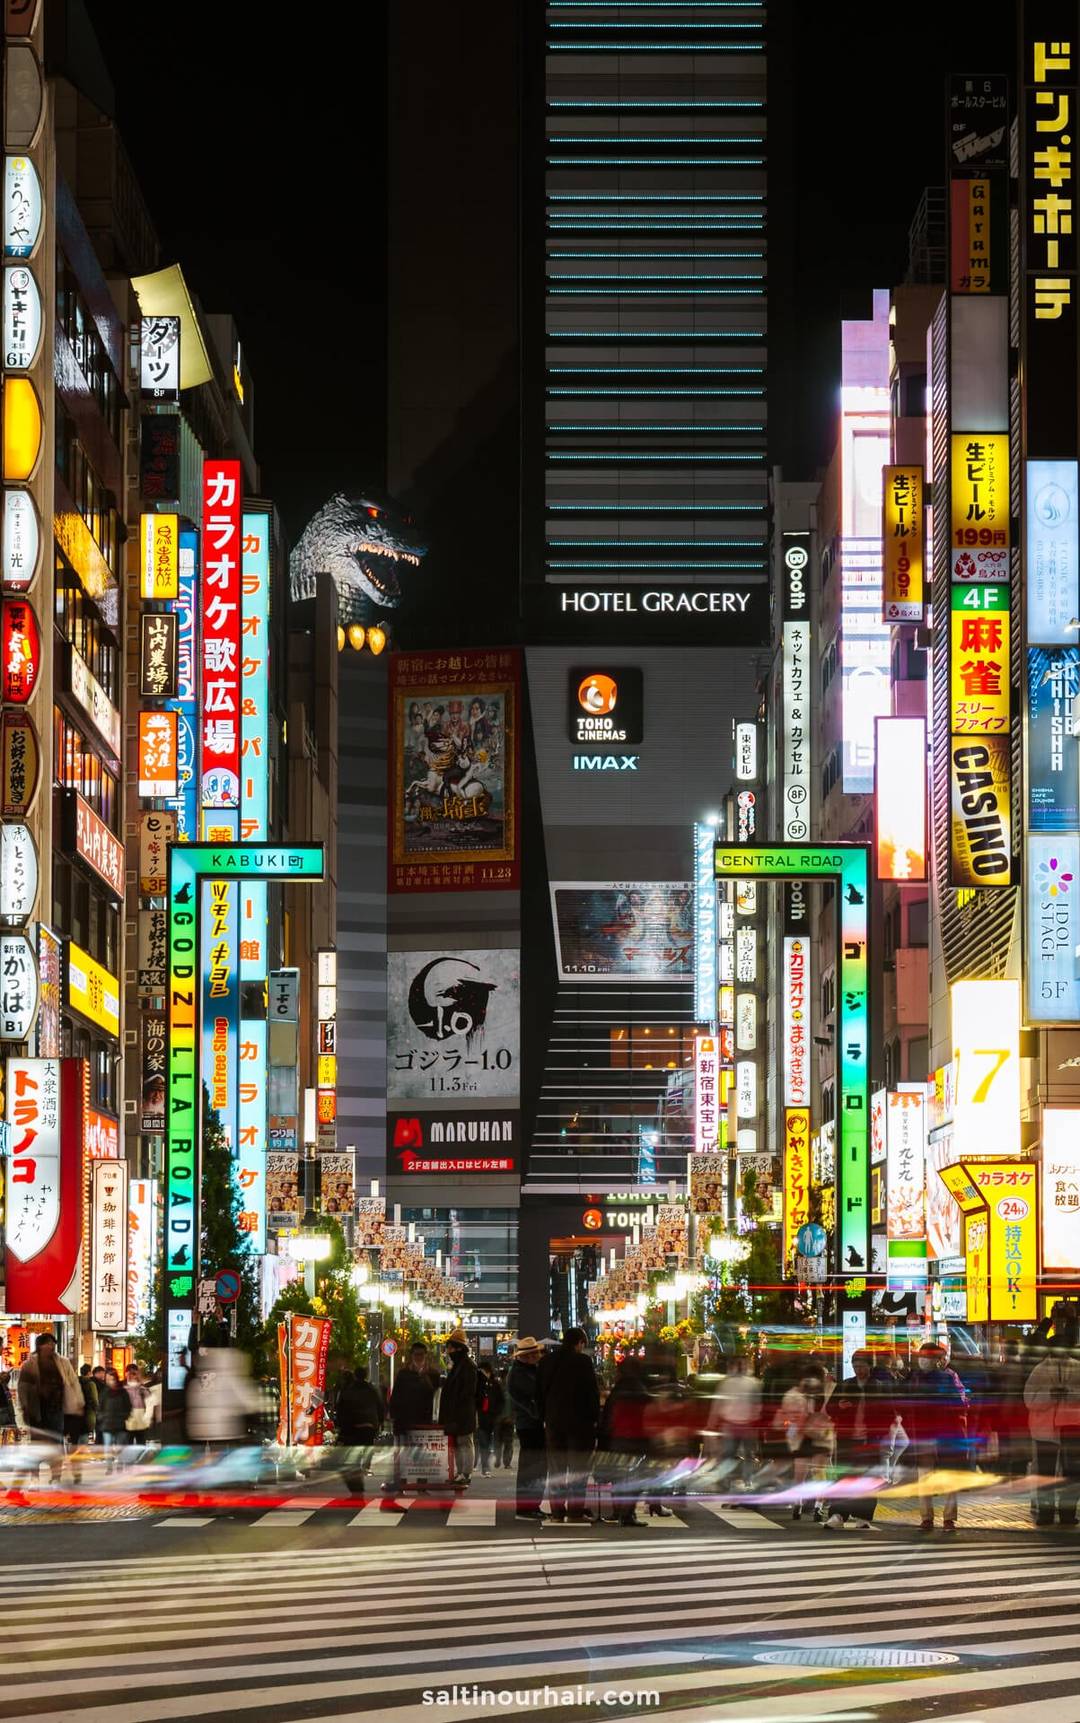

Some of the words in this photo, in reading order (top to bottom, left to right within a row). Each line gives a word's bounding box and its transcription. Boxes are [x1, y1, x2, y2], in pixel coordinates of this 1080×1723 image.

[1033, 42, 1072, 319] ドン・キホーテ
[12, 247, 26, 256] 7F
[6, 353, 30, 367] 6F
[149, 322, 172, 382] ダーツ
[153, 388, 166, 397] 8F
[965, 442, 986, 522] 生ビール
[892, 474, 909, 538] 生ビール
[954, 528, 1006, 546] 199円
[11, 553, 23, 568] 光
[897, 542, 911, 598] 199円
[785, 546, 809, 609] Booth
[561, 592, 638, 613] HOTEL
[642, 592, 751, 613] GRACERY
[962, 586, 999, 608] 4F
[204, 471, 237, 755] カラオケ歌広場
[147, 617, 170, 684] 山内農場
[959, 616, 1003, 696] 麻雀
[26, 662, 34, 685] 3F
[790, 630, 804, 702] ネットカフェ
[152, 684, 165, 694] 5F
[790, 708, 804, 720] &
[954, 716, 1006, 731] ファイブ
[956, 702, 995, 715] スリー
[577, 718, 613, 730] TOHO
[577, 730, 627, 741] CINEMAS
[241, 533, 261, 961] カラオケ&パーテー館
[741, 734, 752, 774] 東京ビル
[11, 731, 25, 804] お好み焼き
[573, 756, 640, 770] IMAX
[791, 789, 804, 800] 8F
[953, 745, 1009, 877] CASINO
[791, 824, 804, 835] 5F
[480, 866, 512, 879] 11.23
[721, 855, 796, 867] CENTRAL
[801, 855, 843, 867] ROAD
[791, 880, 806, 921] ooth
[6, 915, 24, 925] 1F
[1040, 901, 1055, 961] STAGE
[1056, 902, 1069, 951] IDOL
[4, 945, 26, 954] 新宿
[212, 881, 231, 998] ツモトキヨシ
[564, 965, 596, 973] 11.10
[789, 953, 805, 1007] カラオケ
[3, 956, 26, 1014] かっぱ
[1041, 981, 1068, 999] 5F
[5, 1021, 23, 1032] B1
[172, 912, 194, 1114] GODZILLA
[212, 1017, 229, 1052] Shop
[212, 1055, 228, 1085] Free
[429, 1077, 461, 1091] 11.3
[844, 941, 866, 1212] ゴジラロード
[42, 1062, 57, 1129] 大衆酒場
[212, 1087, 228, 1109] Tax
[699, 1059, 715, 1153] 新宿東宝ビル
[13, 1070, 39, 1184] トラノコ
[239, 1040, 260, 1232] カラオケ館
[270, 1128, 296, 1138] つり具
[430, 1121, 513, 1143] MARUHAN
[408, 1159, 508, 1171] 2F店舗出入口はビル左側
[898, 1147, 915, 1182] 九十九
[978, 1170, 1034, 1186] カラオケ
[172, 1138, 194, 1233] ROAD
[1002, 1201, 1025, 1216] 24H
[102, 1201, 117, 1266] 珈琲茶館
[100, 1273, 120, 1293] 集
[1003, 1225, 1023, 1311] 持込OK!
[294, 1321, 320, 1442] カラオケ
